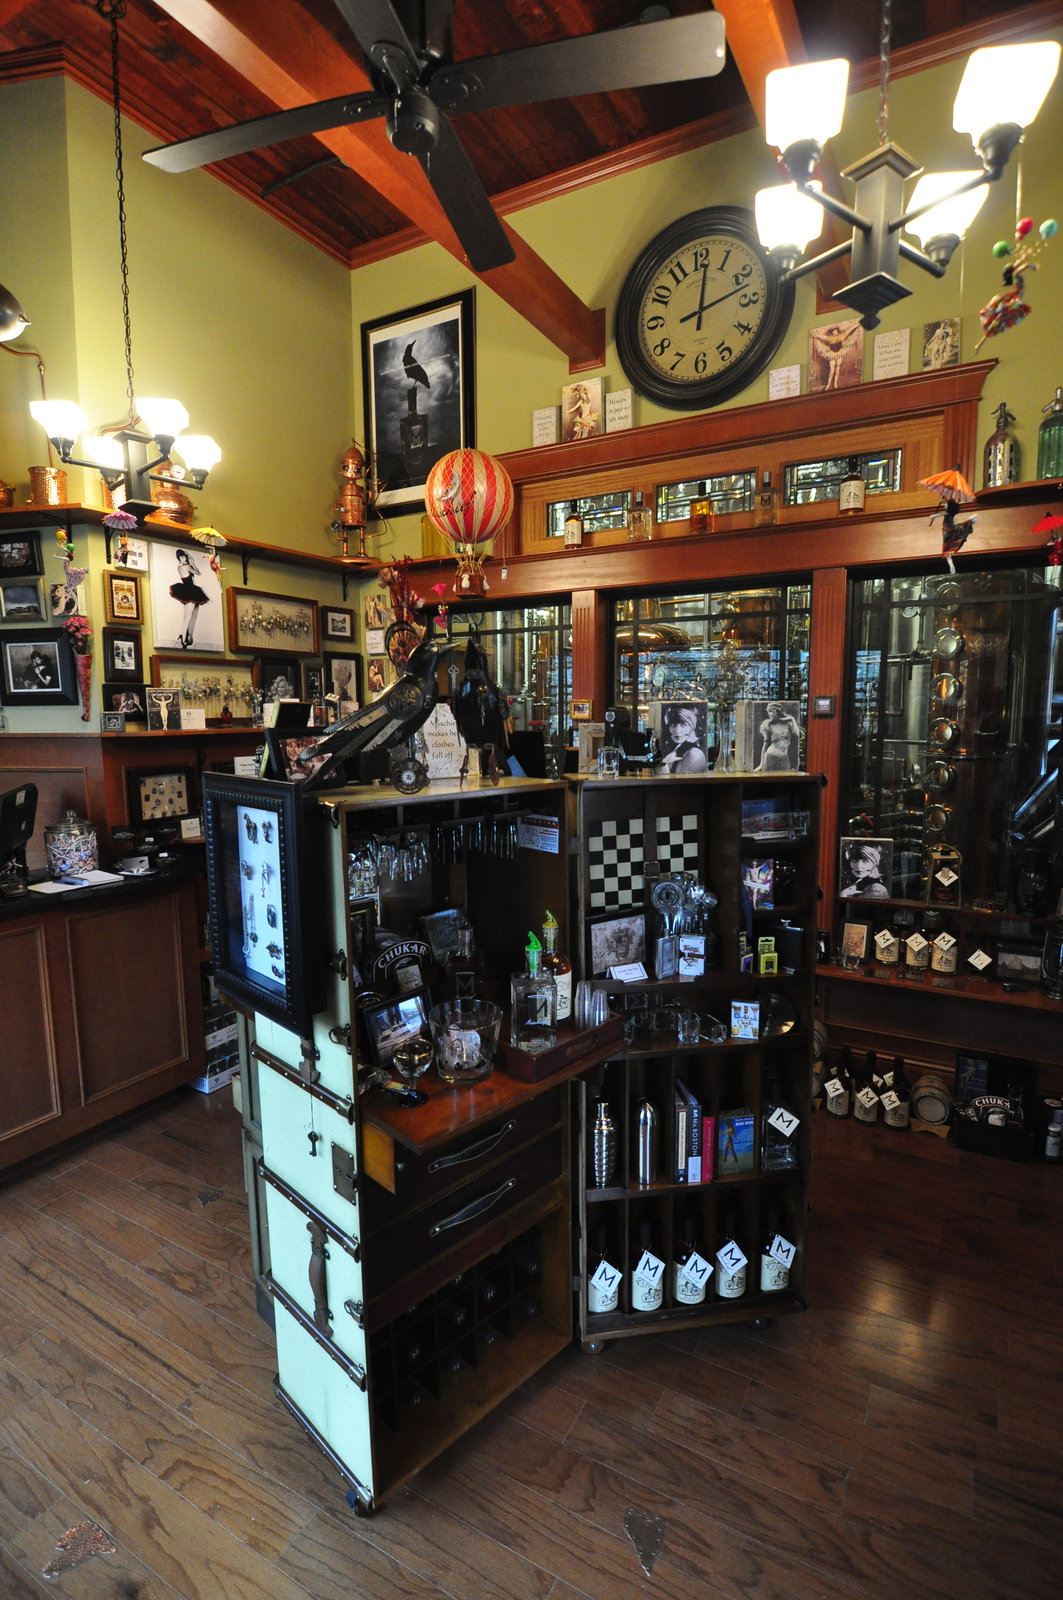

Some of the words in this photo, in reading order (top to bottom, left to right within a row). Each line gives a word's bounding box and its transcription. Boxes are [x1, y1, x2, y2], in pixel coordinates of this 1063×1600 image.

[692, 248, 710, 272] 12
[716, 249, 731, 272] 1
[667, 260, 690, 287] 11
[732, 264, 752, 286] 2
[652, 285, 672, 308] 10
[739, 292, 759, 308] 3
[646, 316, 665, 331] 9
[733, 321, 753, 336] 4
[653, 338, 671, 357] 8
[716, 340, 733, 362] 5
[669, 352, 687, 371] 7
[694, 352, 707, 374] 6
[430, 719, 456, 727] Mischie
[432, 752, 443, 760] fall
[444, 751, 454, 760] off
[377, 943, 428, 969] CHUKAR
[975, 1097, 1010, 1109] CHUKA
[776, 1111, 793, 1129] M
[724, 1247, 742, 1267] M
[776, 1240, 791, 1260] M
[598, 1267, 616, 1288] M
[642, 1257, 659, 1278] M
[689, 1259, 707, 1280] M
